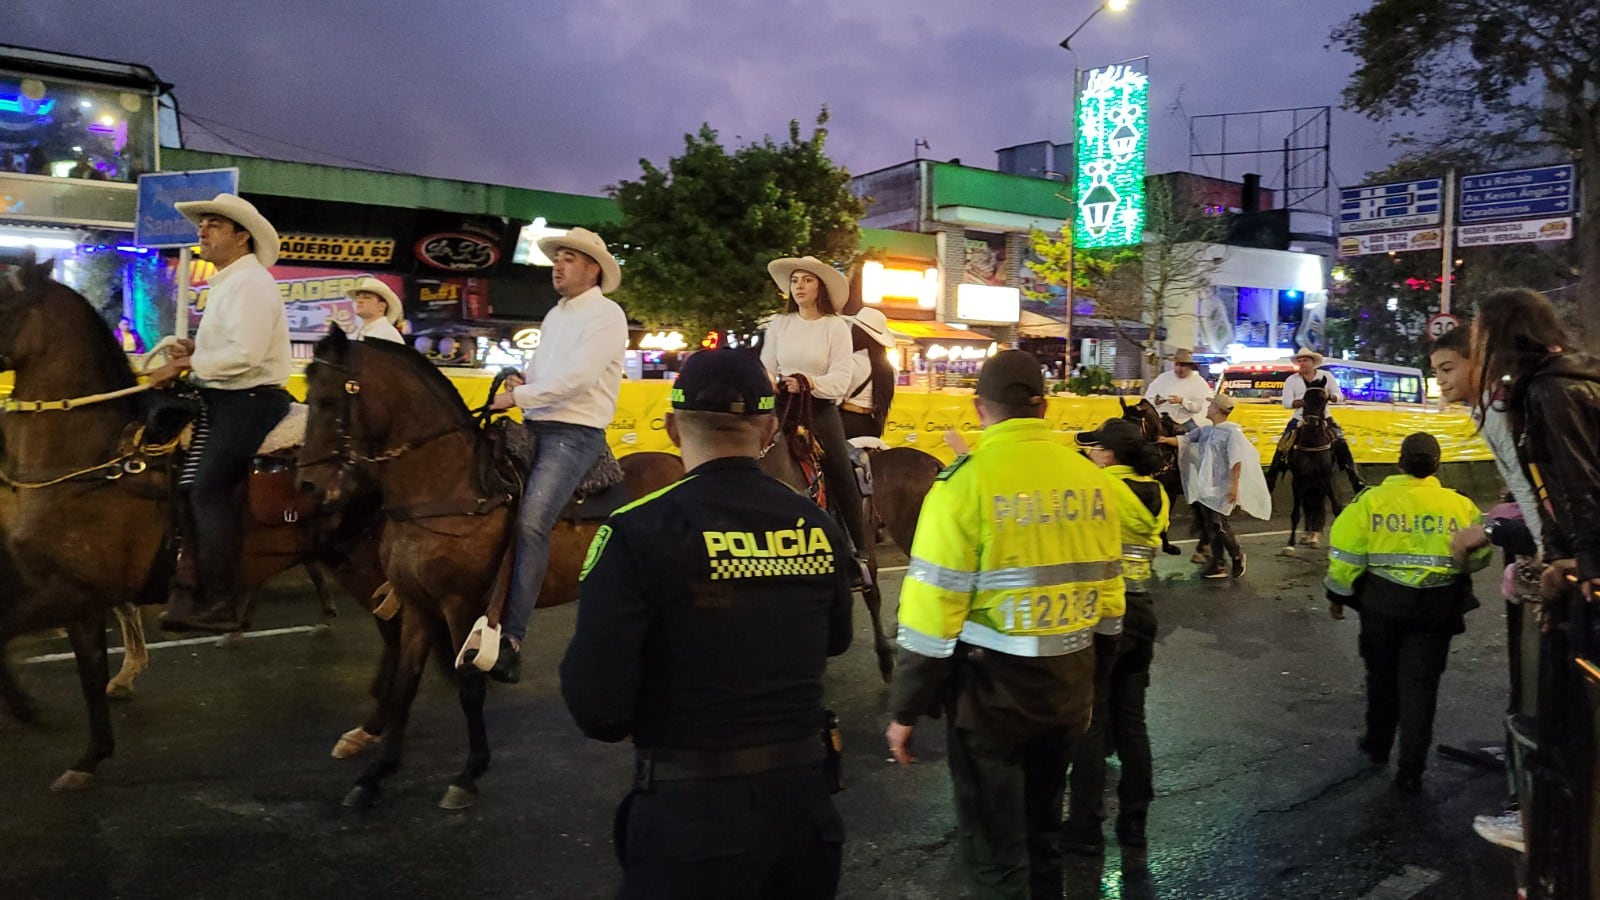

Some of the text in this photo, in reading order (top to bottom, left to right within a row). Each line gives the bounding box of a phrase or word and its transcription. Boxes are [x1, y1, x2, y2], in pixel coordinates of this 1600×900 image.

[280, 240, 390, 257] ADERO LA 63
[1433, 321, 1456, 337] 30
[993, 488, 1107, 529] POLICIA
[1371, 513, 1460, 535] POLICIA
[702, 517, 833, 557] POLICÍA
